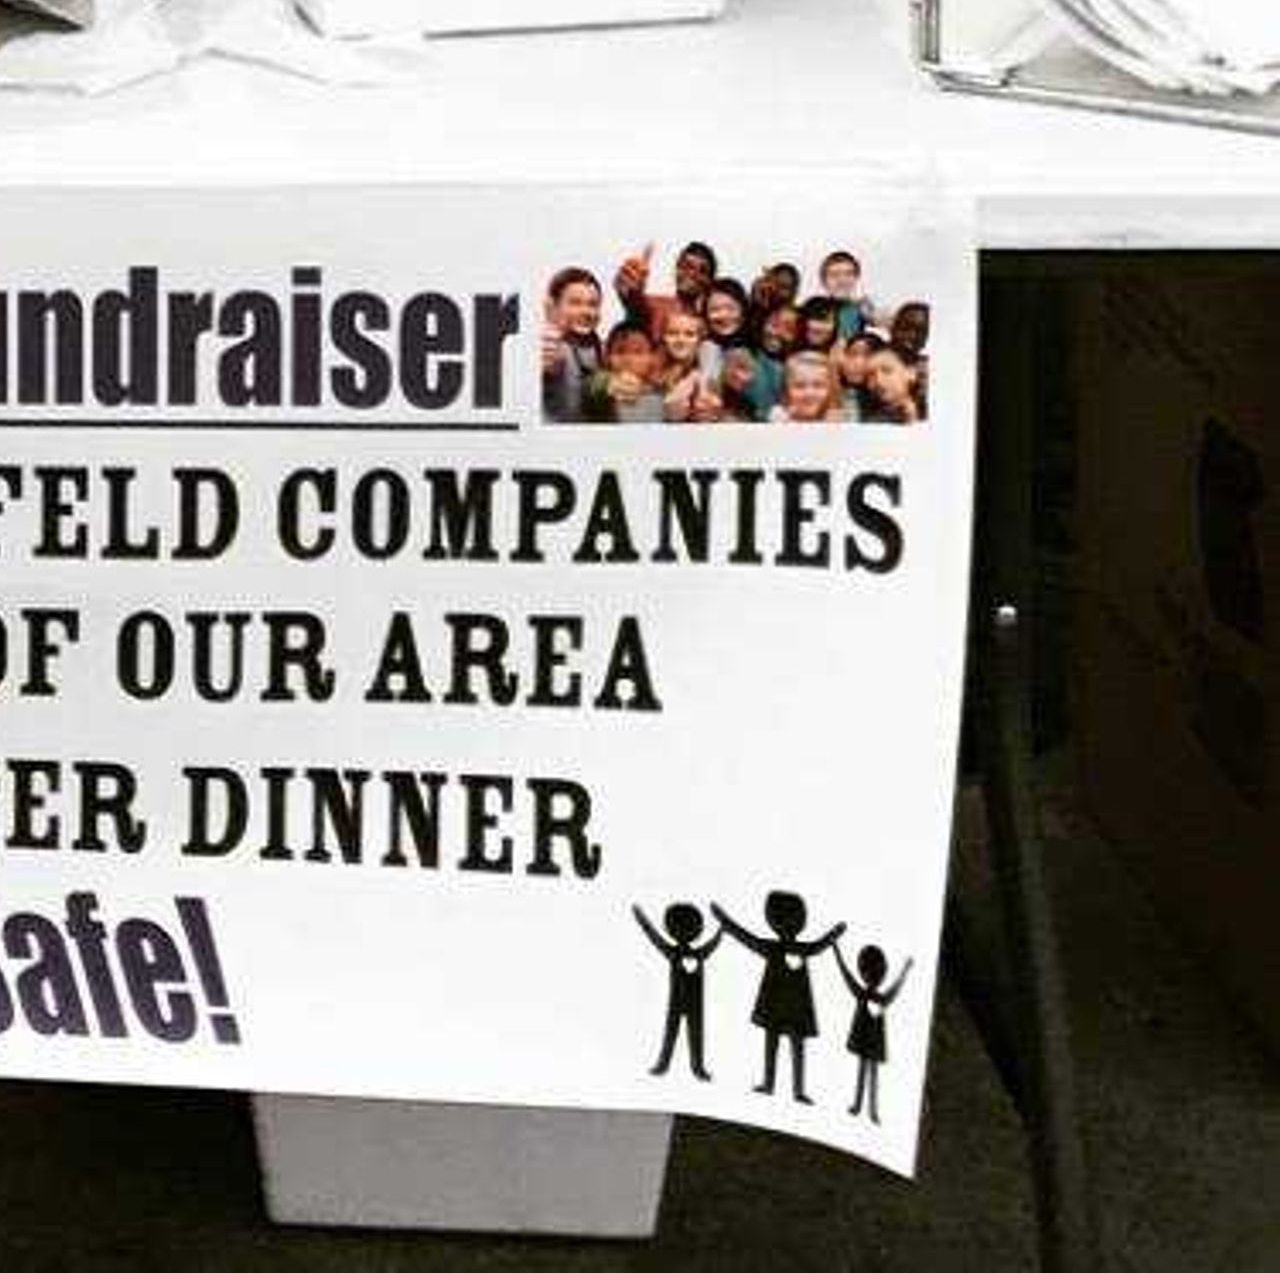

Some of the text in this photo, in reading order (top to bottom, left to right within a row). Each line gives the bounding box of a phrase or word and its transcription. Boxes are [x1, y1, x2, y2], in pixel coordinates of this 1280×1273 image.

[277, 467, 904, 574] COMPANIES
[116, 610, 336, 703] OUR
[364, 611, 663, 712] AREA
[181, 766, 602, 880] DINNER
